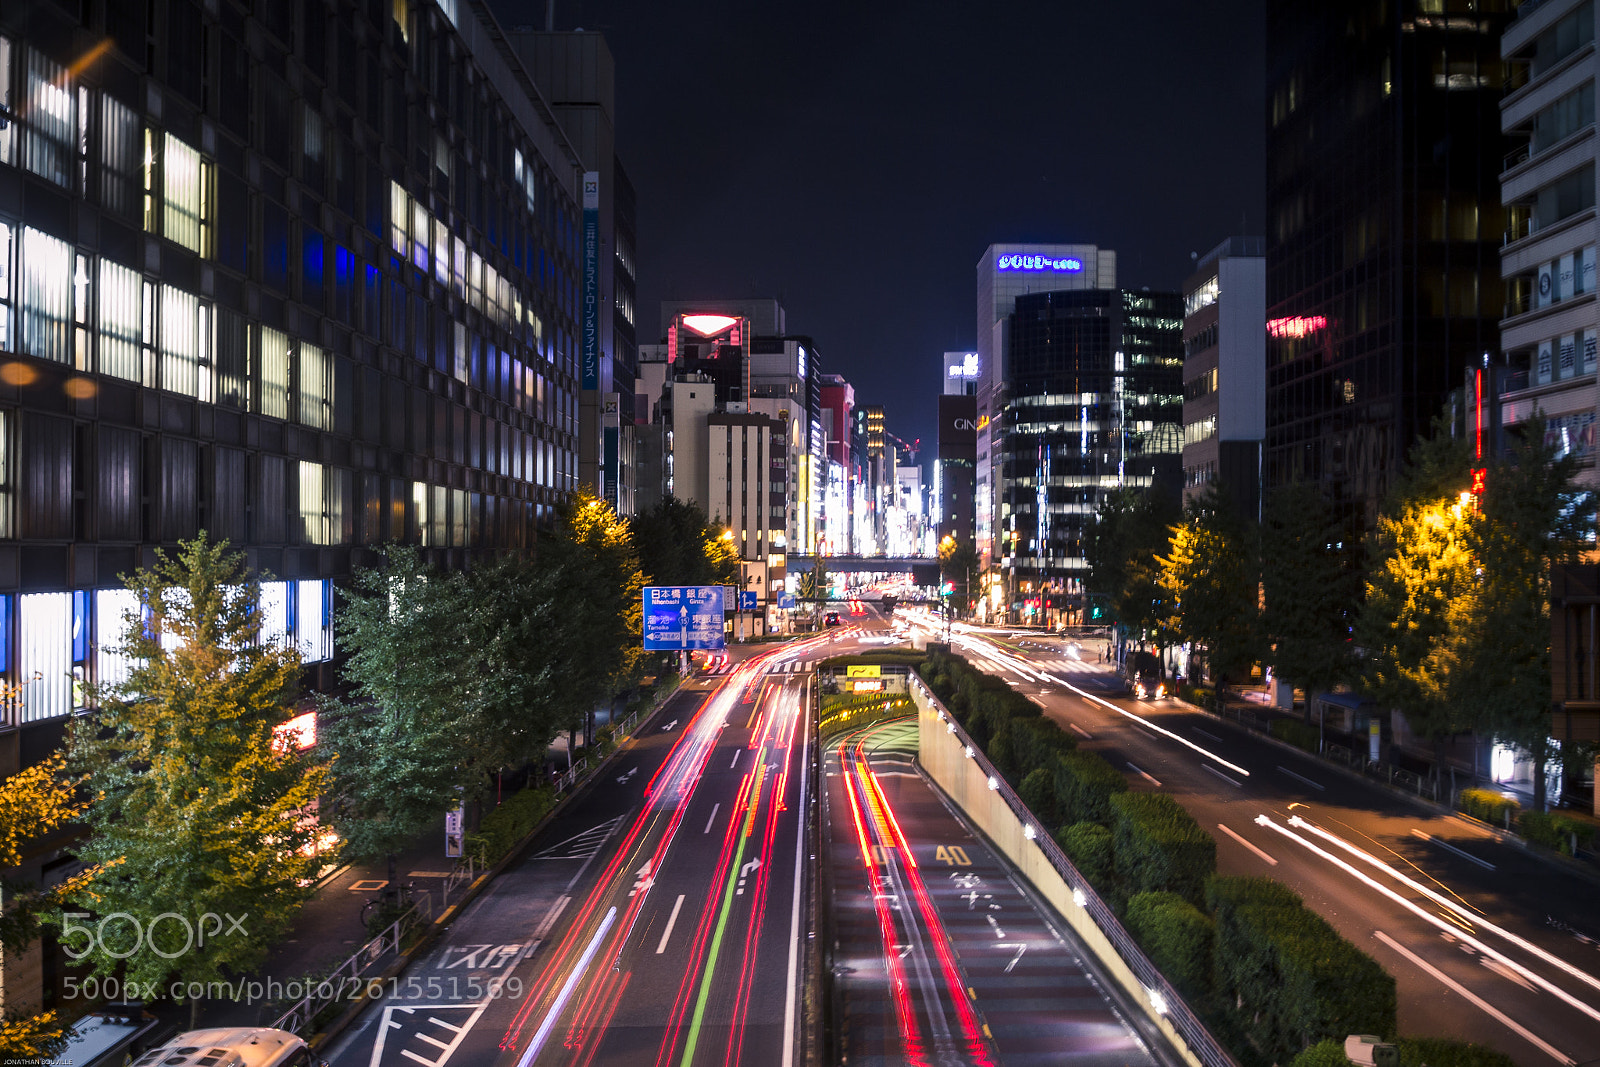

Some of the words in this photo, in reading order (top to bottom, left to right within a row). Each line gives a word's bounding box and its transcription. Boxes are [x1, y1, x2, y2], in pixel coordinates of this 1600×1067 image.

[651, 589, 681, 599] 日本橋
[686, 588, 708, 599] 銀座
[692, 614, 722, 624] 東銀座
[935, 844, 973, 866] 40
